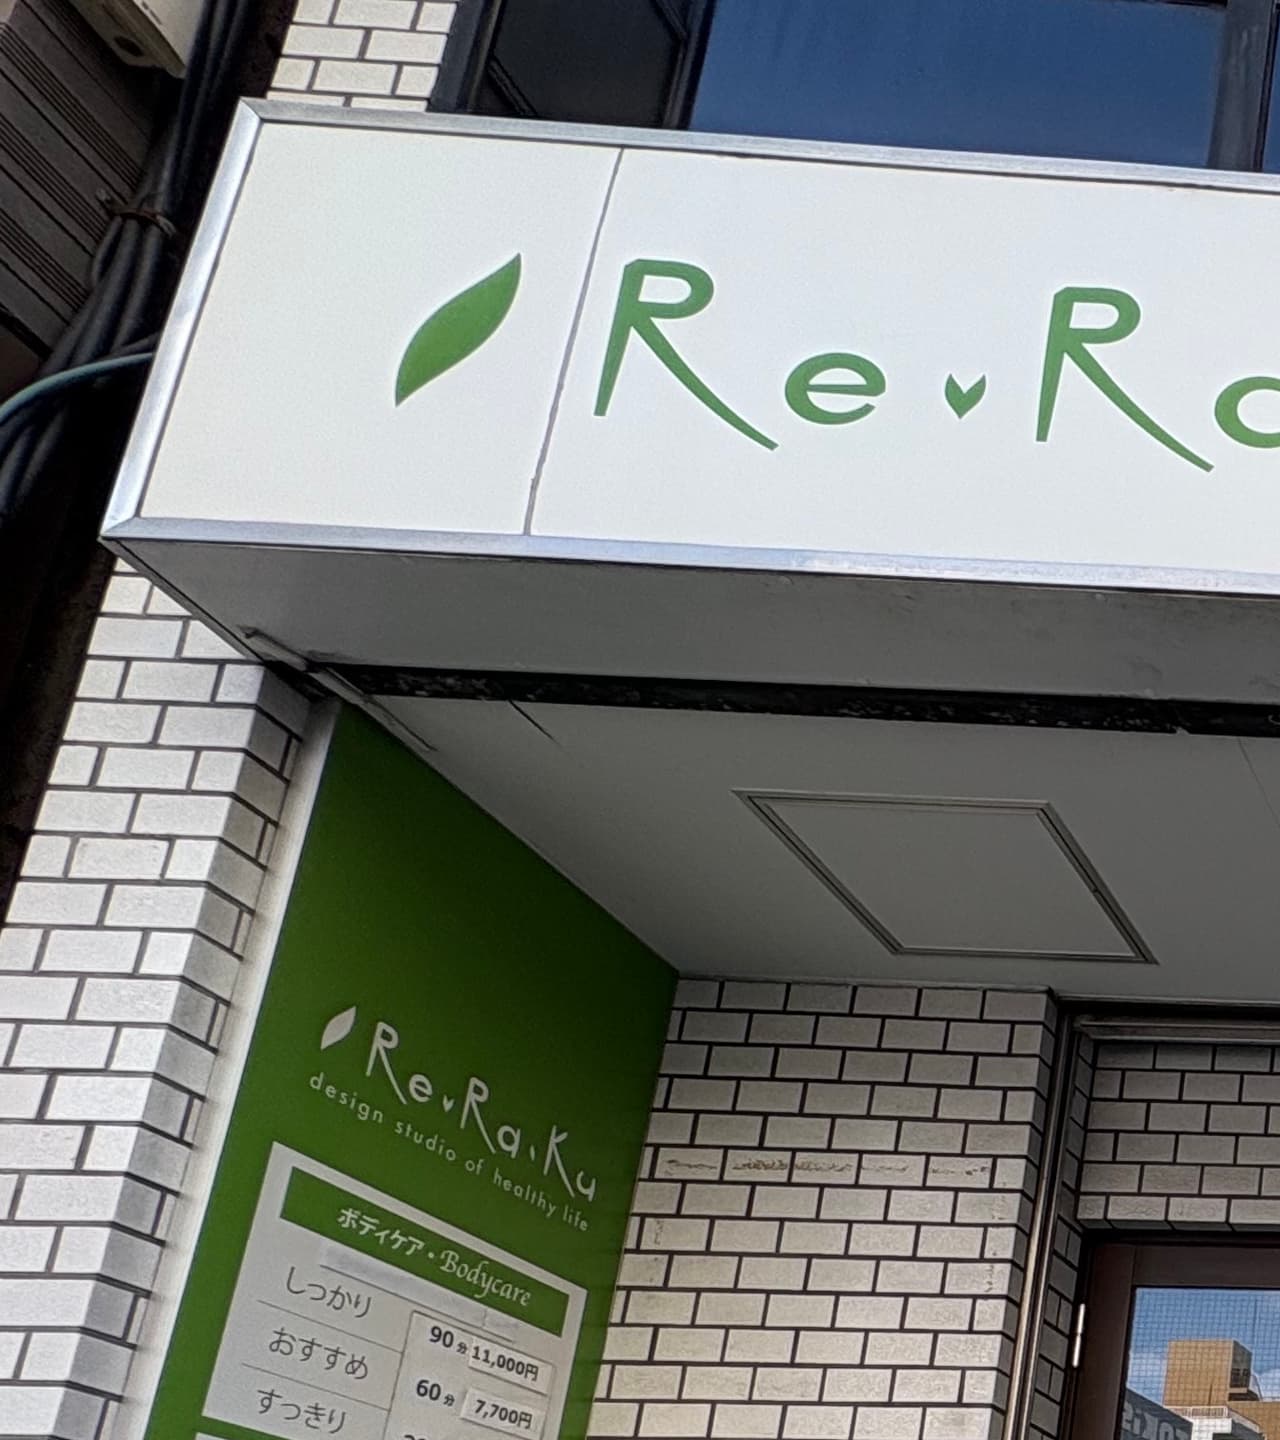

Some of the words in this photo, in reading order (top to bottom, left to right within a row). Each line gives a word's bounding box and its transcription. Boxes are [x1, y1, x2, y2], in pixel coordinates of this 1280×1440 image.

[309, 1071, 385, 1124] design
[395, 1119, 457, 1162] studio
[464, 1157, 485, 1177] of
[492, 1167, 558, 1218] healthy
[562, 1206, 589, 1232] life
[285, 1266, 372, 1318] しっかり
[269, 1327, 368, 1380] おすすめ
[257, 1387, 347, 1434] すっきり
[474, 1398, 533, 1430] 7,700円
